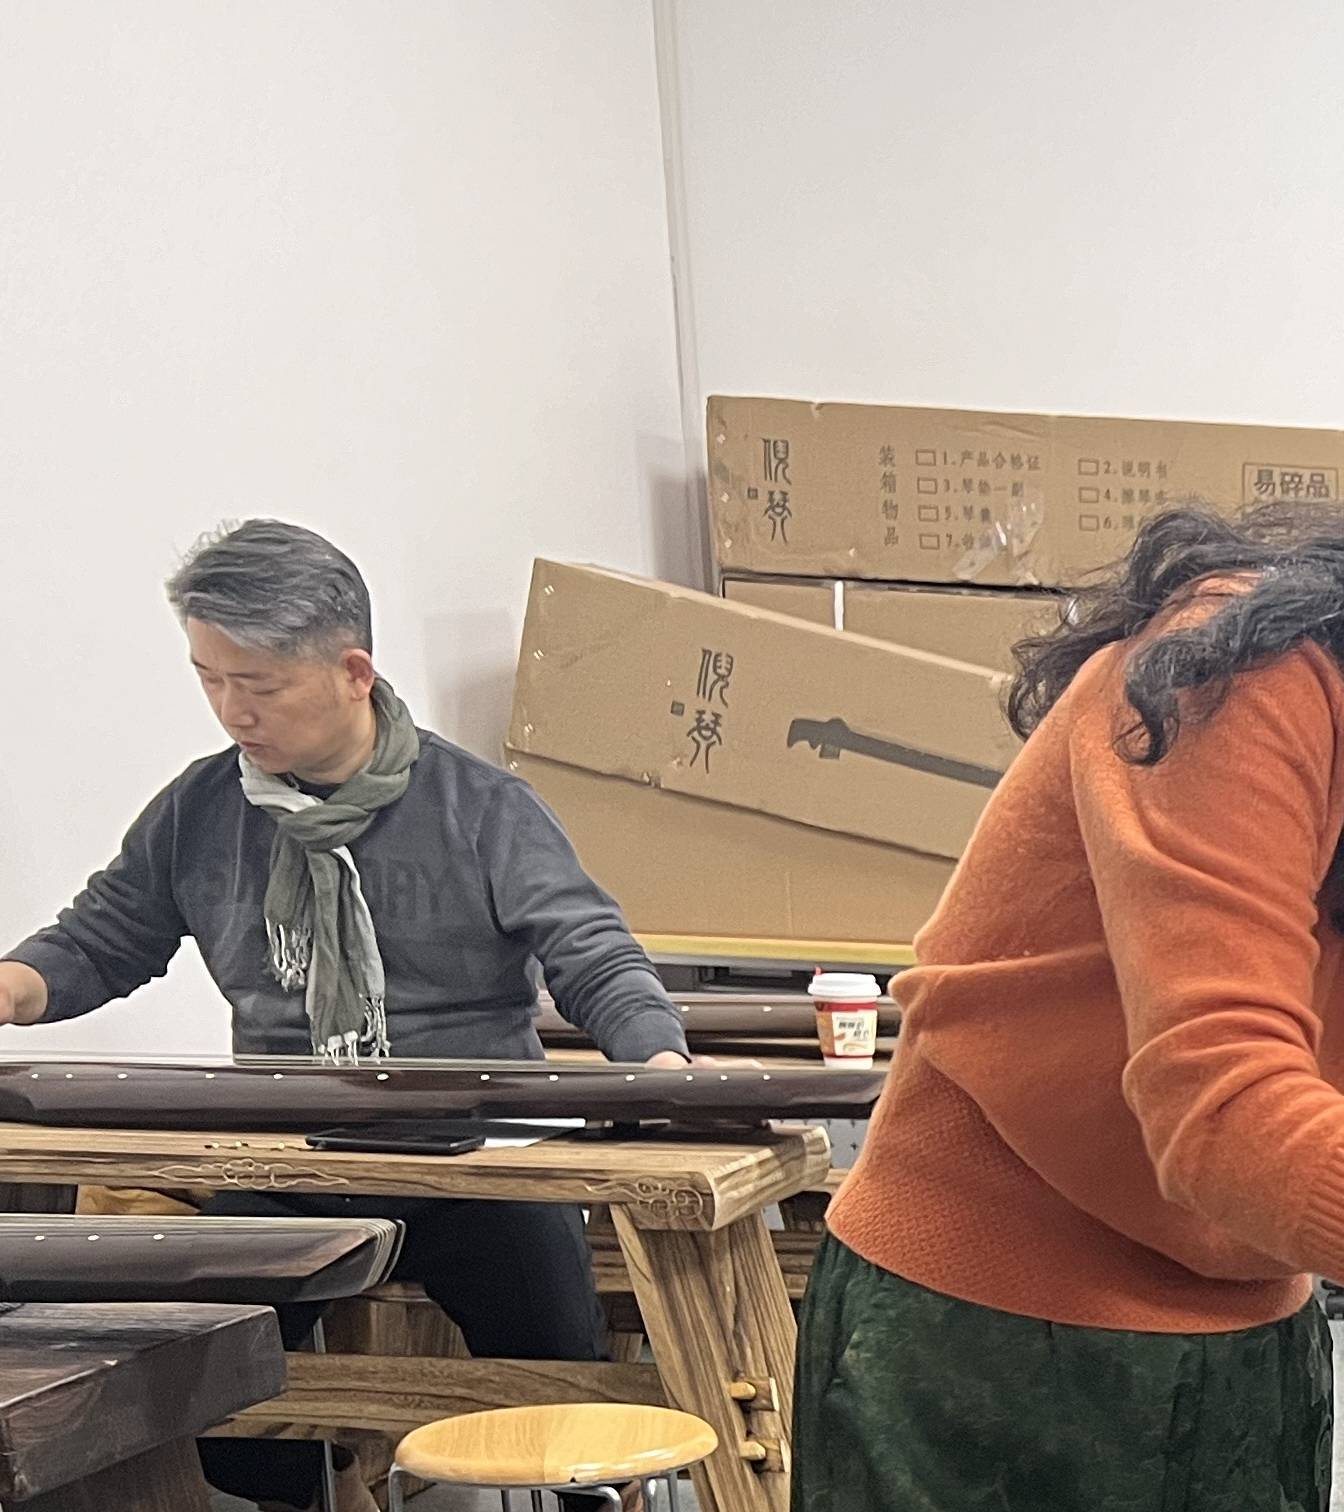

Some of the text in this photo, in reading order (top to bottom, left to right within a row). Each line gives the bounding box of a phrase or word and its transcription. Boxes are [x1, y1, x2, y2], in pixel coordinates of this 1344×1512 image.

[942, 449, 1042, 471] 1.产品合格证
[878, 444, 899, 547] 装箱物品
[1254, 468, 1330, 499] 易碎品
